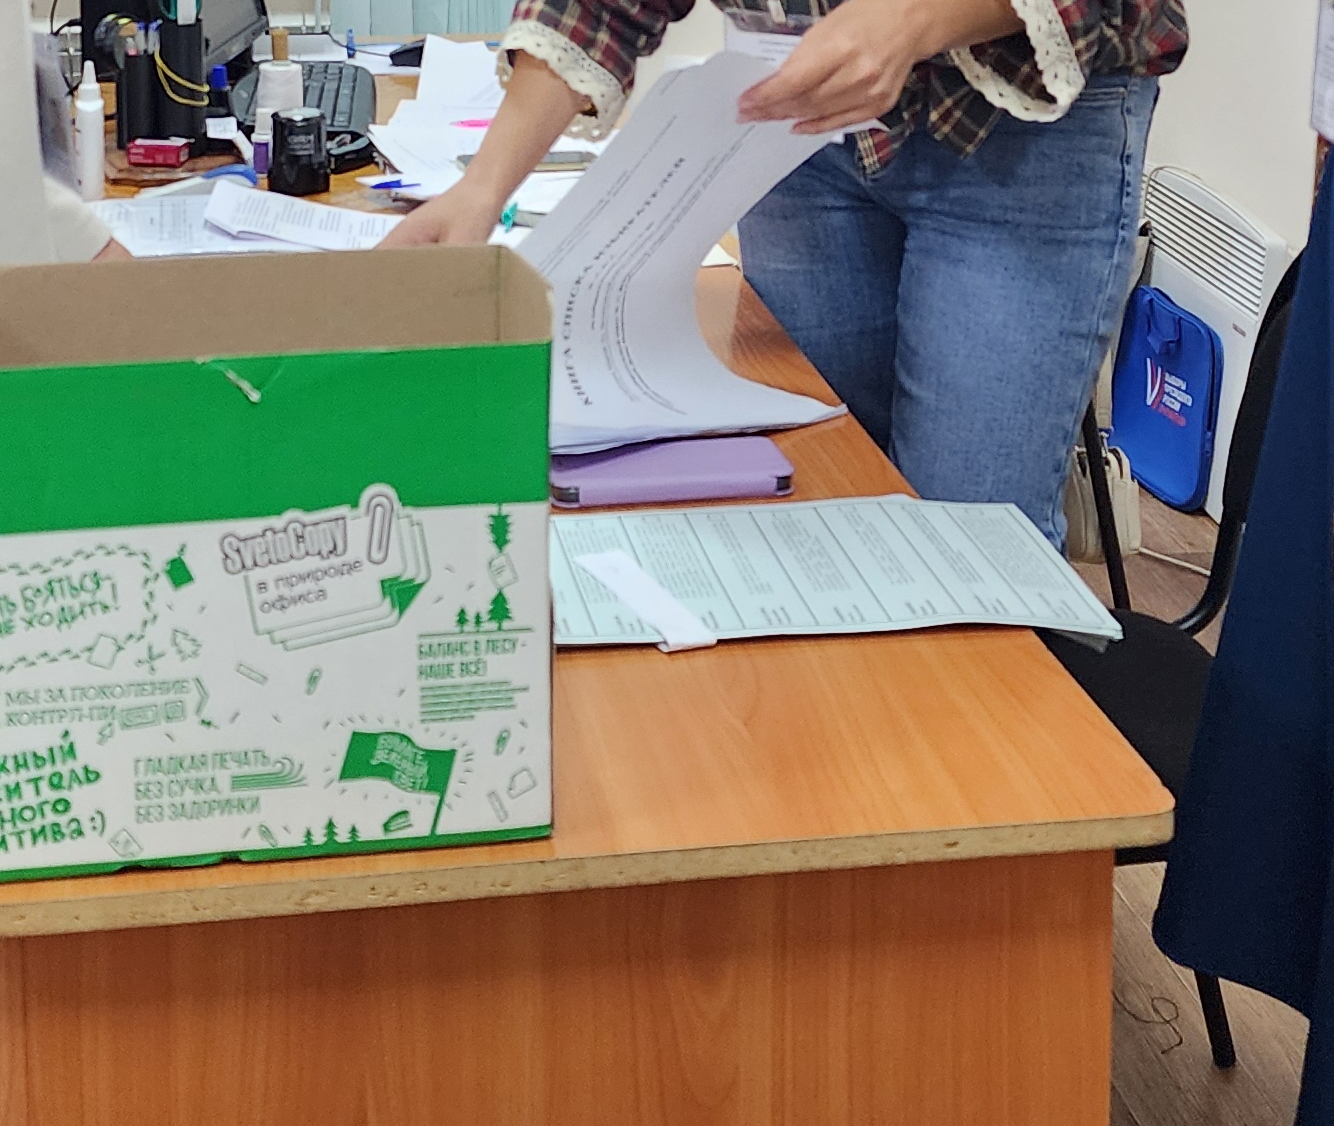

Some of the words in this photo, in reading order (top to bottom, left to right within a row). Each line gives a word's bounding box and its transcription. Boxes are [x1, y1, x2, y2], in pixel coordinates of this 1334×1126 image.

[220, 516, 348, 575] SvetoCopy
[274, 560, 363, 589] природе
[259, 589, 328, 613] офиса
[486, 638, 518, 655] ЛЕСУ
[5, 688, 41, 707] МЫ
[45, 686, 66, 704] ЗА
[69, 678, 192, 703] ПОКОЛЕНИЕ
[134, 753, 208, 777] ГЛАДКАЯ
[134, 780, 164, 801] БЕЗ
[167, 777, 220, 799] СУЧКА
[135, 804, 165, 824] БЕЗ
[167, 796, 261, 821] ЗАДОРИНКИ
